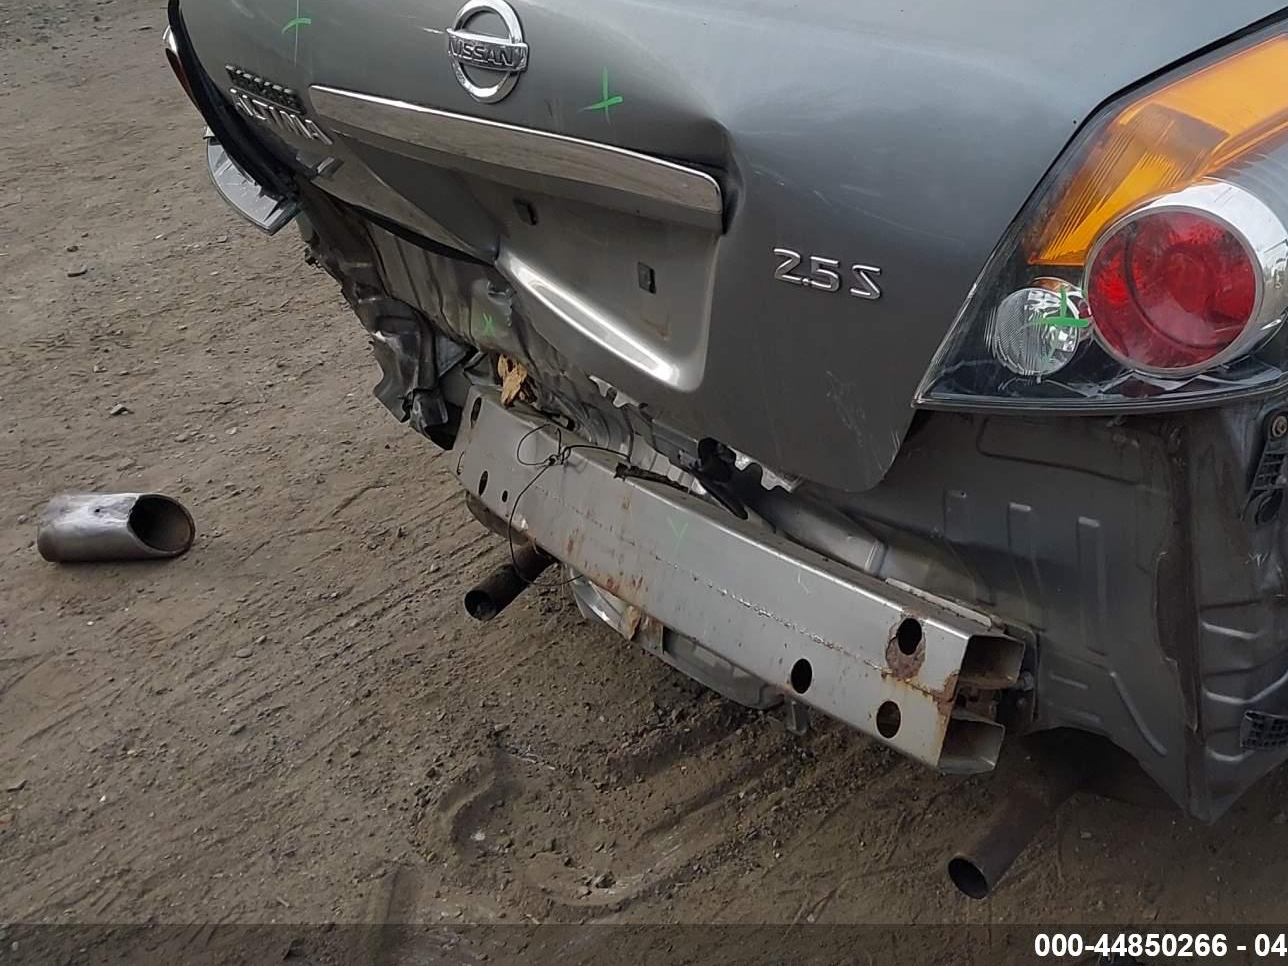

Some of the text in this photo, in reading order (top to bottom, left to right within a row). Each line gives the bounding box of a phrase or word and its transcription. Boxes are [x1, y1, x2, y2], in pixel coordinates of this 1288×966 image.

[449, 37, 515, 67] NISSAN
[773, 248, 881, 300] 2.5 S
